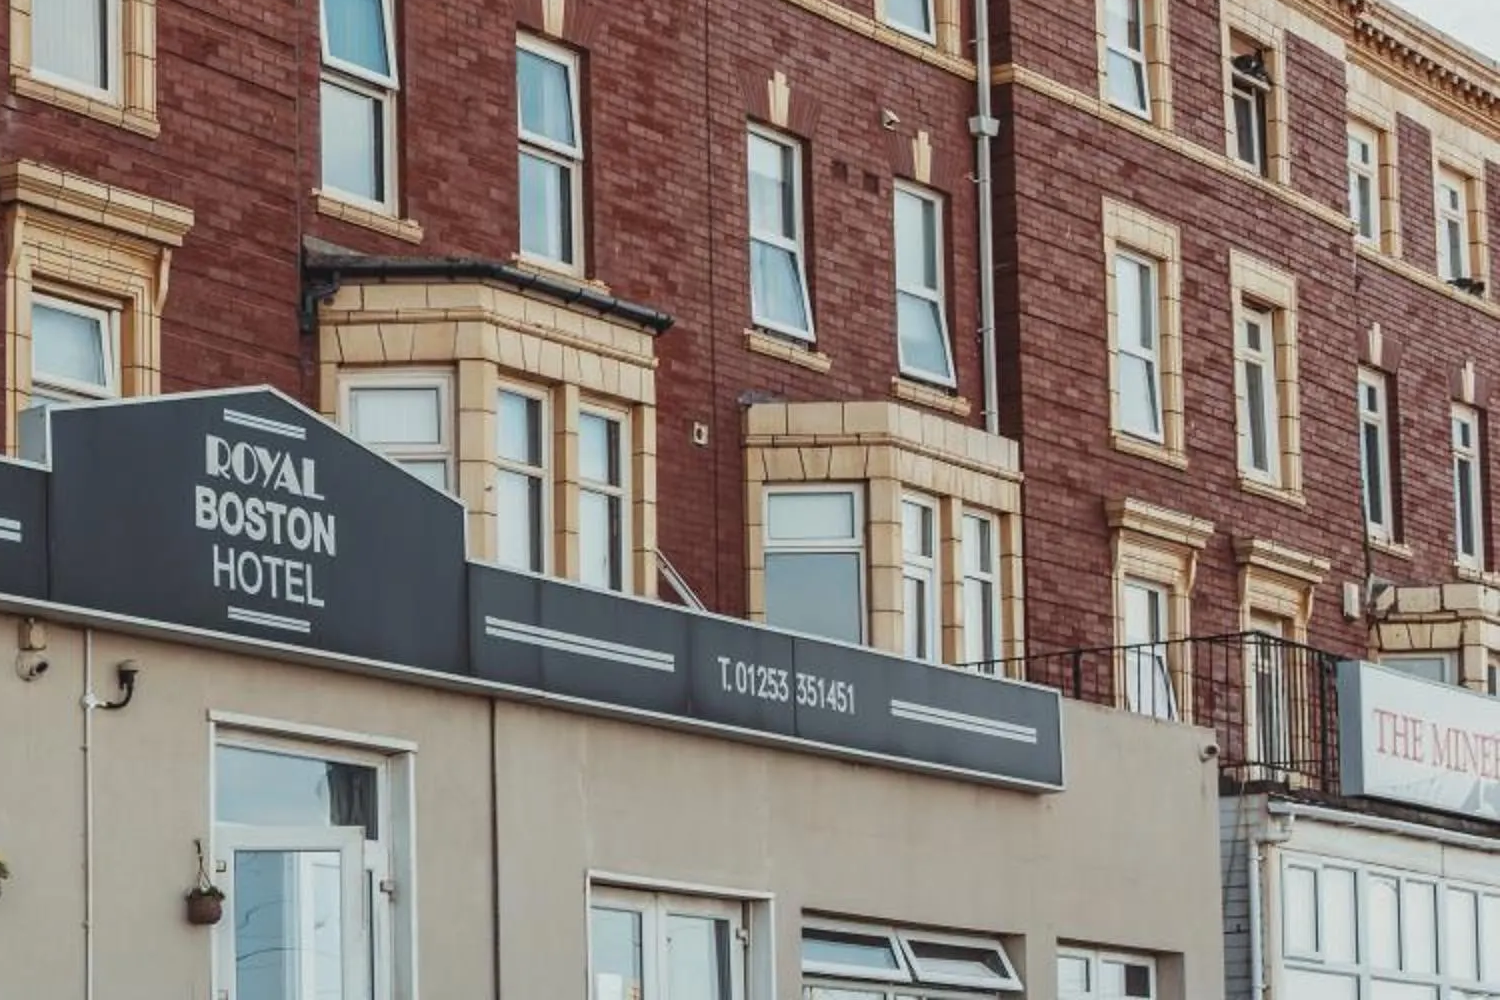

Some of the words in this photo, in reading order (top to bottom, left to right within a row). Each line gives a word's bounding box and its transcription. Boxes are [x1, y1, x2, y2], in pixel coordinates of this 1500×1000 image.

[206, 434, 324, 500] ROYAL
[196, 485, 335, 556] BOSTON
[213, 544, 324, 607] HOTEL
[796, 673, 854, 714] 351451
[1373, 708, 1423, 763] THE
